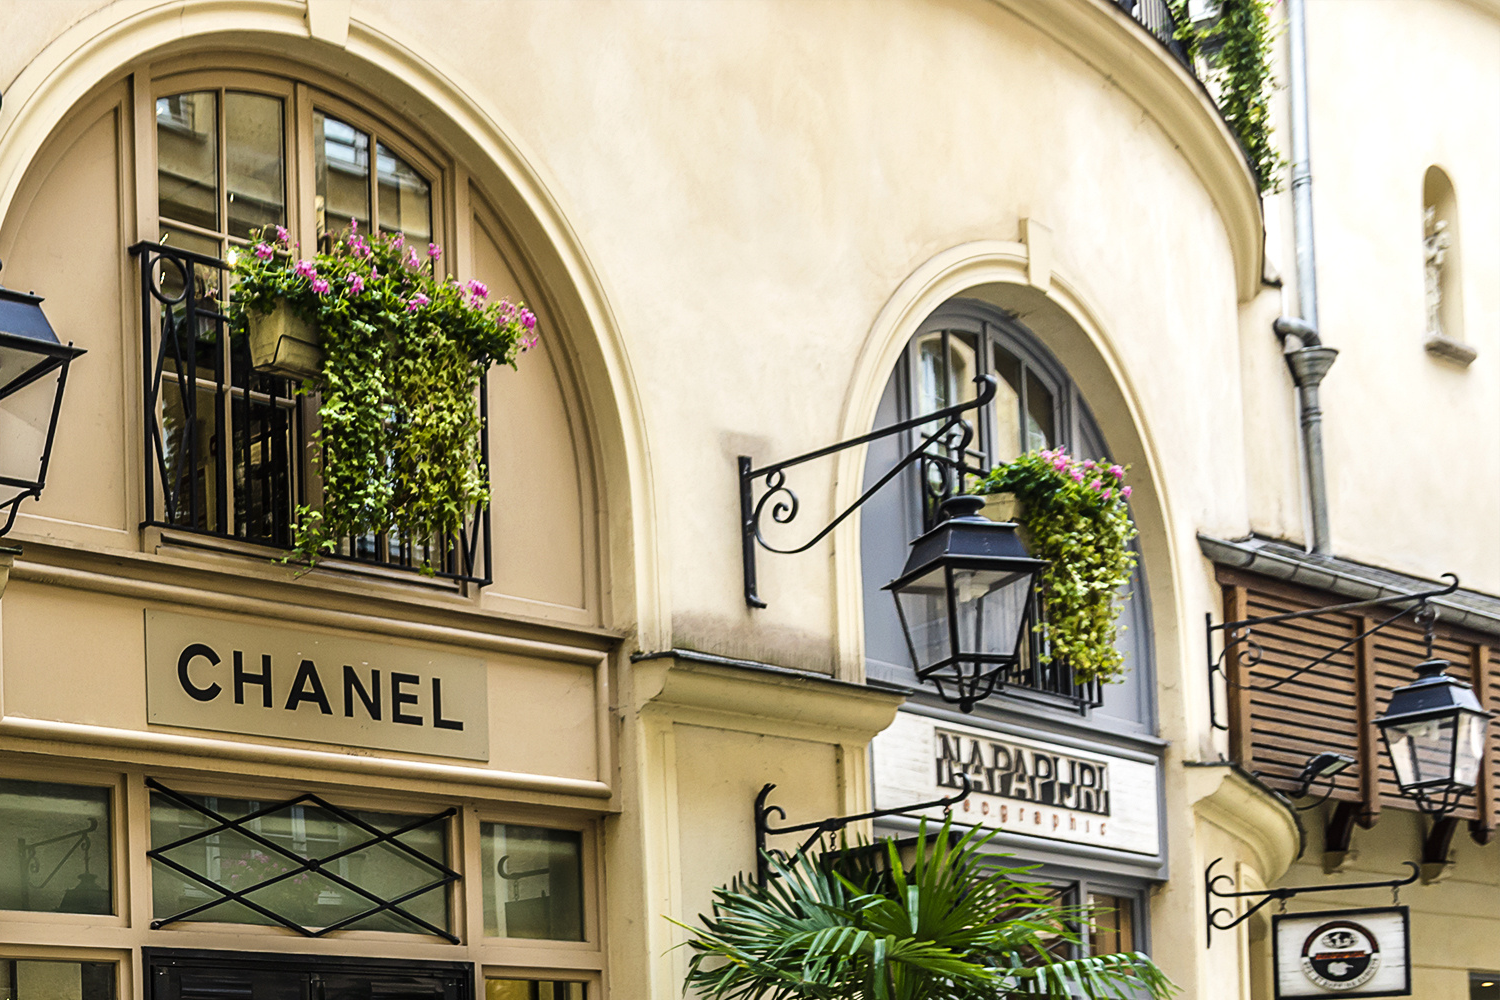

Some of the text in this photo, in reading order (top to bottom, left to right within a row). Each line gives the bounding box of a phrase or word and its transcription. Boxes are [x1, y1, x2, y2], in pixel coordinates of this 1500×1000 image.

[177, 643, 464, 731] CHANEL
[936, 731, 1110, 815] NAPAPIJRI
[945, 796, 1107, 836] eographic
